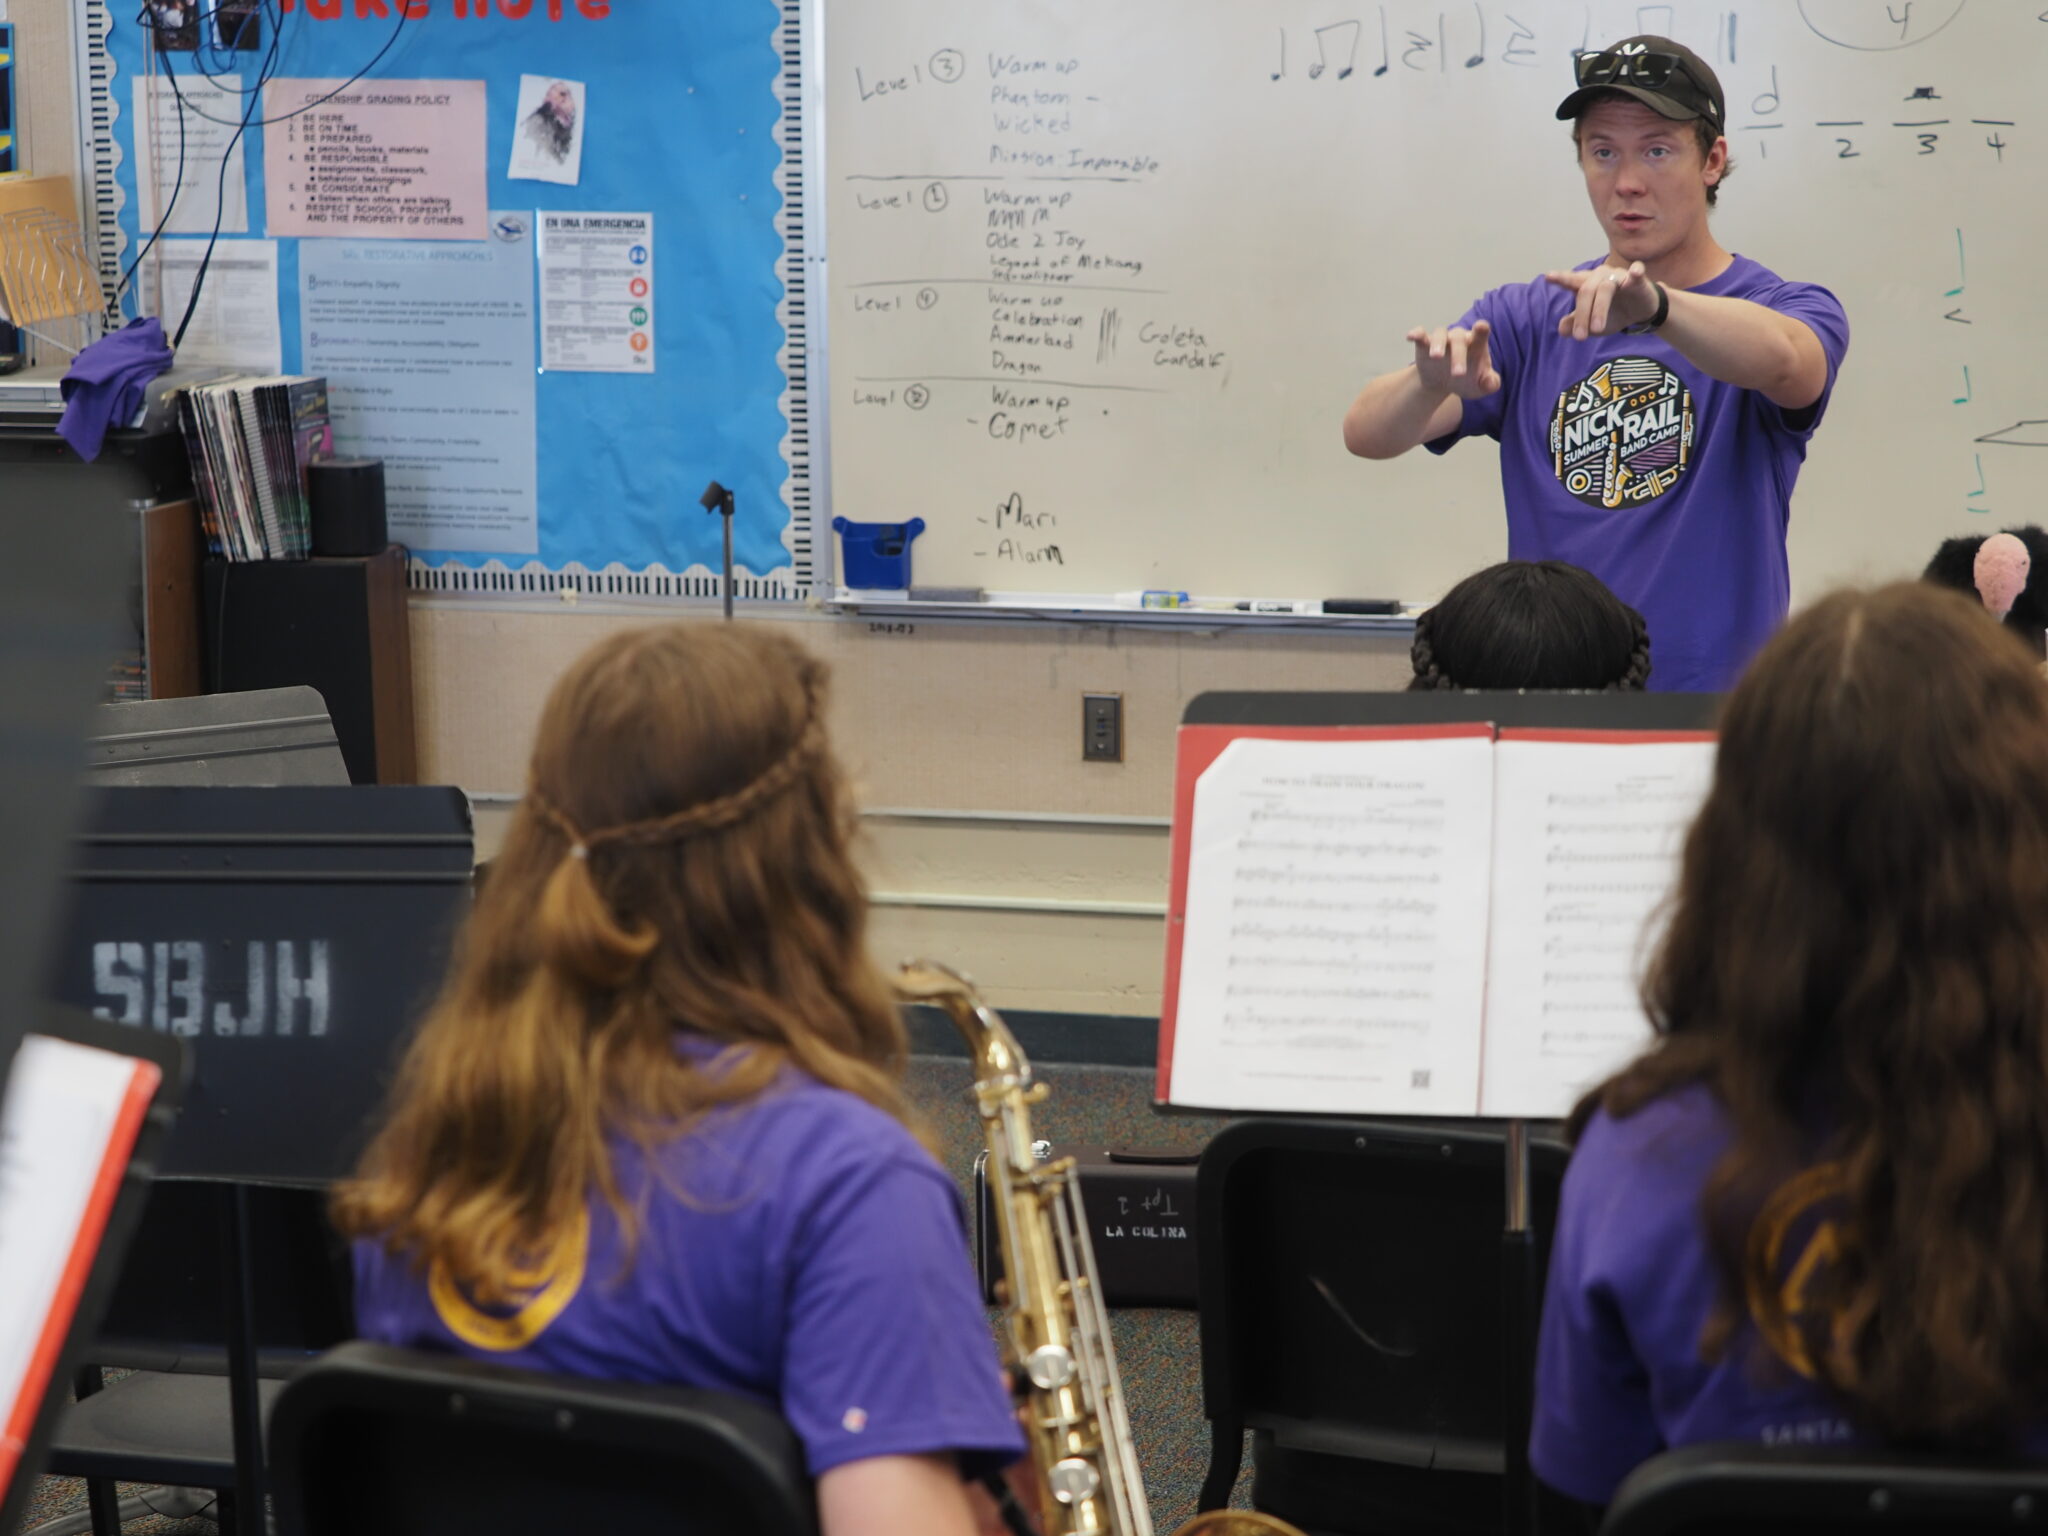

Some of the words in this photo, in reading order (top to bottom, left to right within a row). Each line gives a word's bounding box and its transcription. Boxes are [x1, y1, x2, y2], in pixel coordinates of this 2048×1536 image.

[988, 52, 1046, 79] Warm
[1056, 59, 1079, 73] up
[855, 64, 922, 101] Level
[366, 95, 411, 104] GRADING
[415, 95, 450, 104] POLICY
[991, 85, 1070, 107] Phantom
[303, 114, 315, 122] BE
[319, 114, 344, 122] HERE
[303, 124, 315, 132] BE
[319, 124, 332, 132] ON
[336, 124, 358, 132] TIME
[993, 111, 1071, 134] Wicked
[304, 134, 316, 142] BE
[320, 135, 372, 143] PREPARED
[1835, 138, 1860, 158] 2
[1917, 134, 1939, 155] 3
[1987, 133, 2005, 163] 4
[304, 154, 317, 162] BE
[321, 155, 389, 163] RESPONSIBLE
[305, 184, 317, 193] BE
[322, 185, 390, 193] CONSIDERATE
[984, 187, 1041, 205] Warm
[1049, 192, 1072, 208] up
[857, 189, 912, 209] Level
[306, 204, 350, 213] RESPECT
[355, 205, 395, 213] SCHOOL
[400, 206, 452, 215] PROPERTY
[307, 214, 328, 222] AND
[331, 215, 348, 223] THE
[353, 215, 404, 224] PROPERTY
[408, 217, 420, 225] OF
[423, 217, 464, 226] OTHERS
[545, 218, 558, 229] EN
[561, 218, 580, 229] UNA
[583, 218, 646, 229] EMERGENCIA
[986, 231, 1020, 248] Ode
[1033, 233, 1045, 248] 2
[1053, 230, 1086, 251] Joy
[1050, 255, 1070, 269] of
[854, 294, 901, 311] Level
[988, 287, 1032, 305] Warm
[992, 307, 1082, 327] Celebration
[992, 350, 1042, 374] Dragon
[853, 388, 894, 406] Level
[992, 383, 1039, 408] Warm
[1046, 396, 1070, 413] up
[988, 411, 1069, 445] Comet
[1564, 399, 1626, 452] NICK
[1623, 399, 1681, 443] RAIL
[1563, 435, 1610, 466] SUMMER
[1620, 439, 1648, 458] BAND
[1648, 424, 1680, 443] CAMP
[998, 541, 1065, 566] Alarm
[93, 939, 330, 1037] SBJH
[1106, 1226, 1124, 1237] LA
[1760, 1418, 1852, 1448] SANTA
